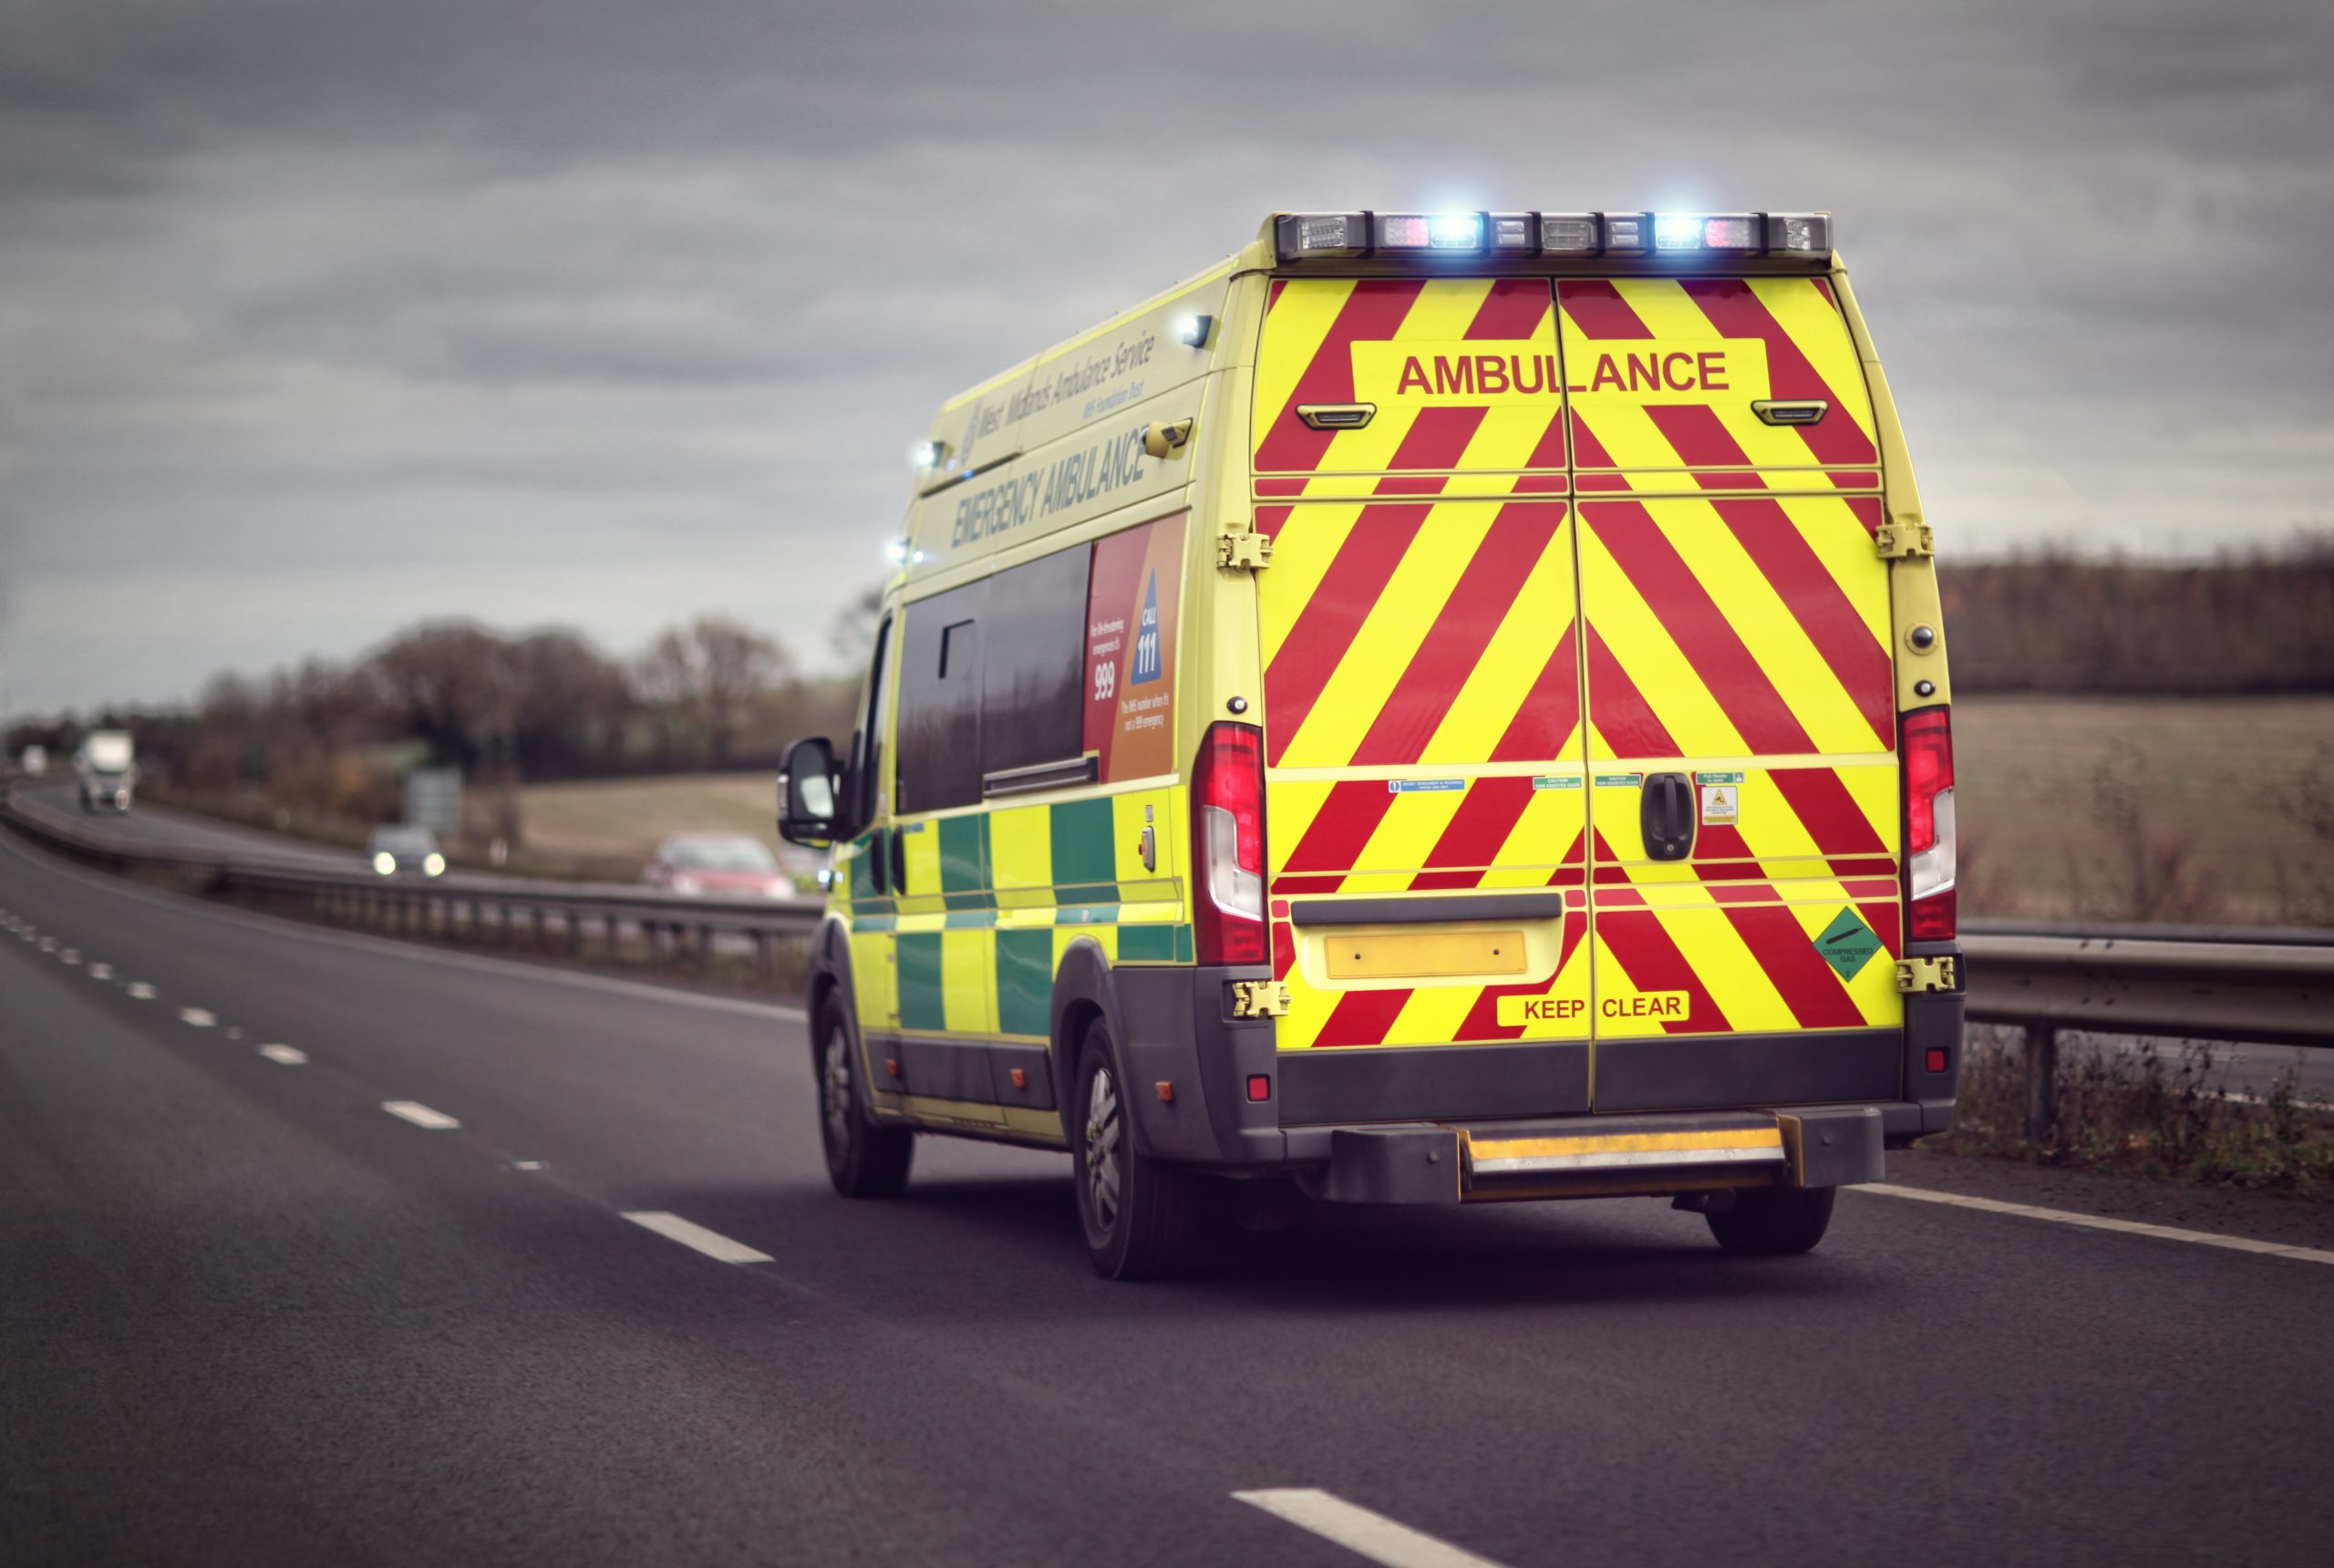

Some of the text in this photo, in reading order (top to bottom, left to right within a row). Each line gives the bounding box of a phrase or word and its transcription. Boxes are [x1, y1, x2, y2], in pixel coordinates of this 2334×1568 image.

[1051, 355, 1111, 407] Ambulance
[1110, 329, 1155, 379] Service
[1396, 352, 1730, 395] AMBULANCE
[951, 468, 1046, 548] EMERGENCY
[1142, 607, 1156, 626] CALL
[1138, 632, 1157, 674] 111
[1095, 661, 1115, 701] 999
[1823, 947, 1874, 955] COMPRESSED
[1524, 996, 1682, 1019] KEEP CLEAR
